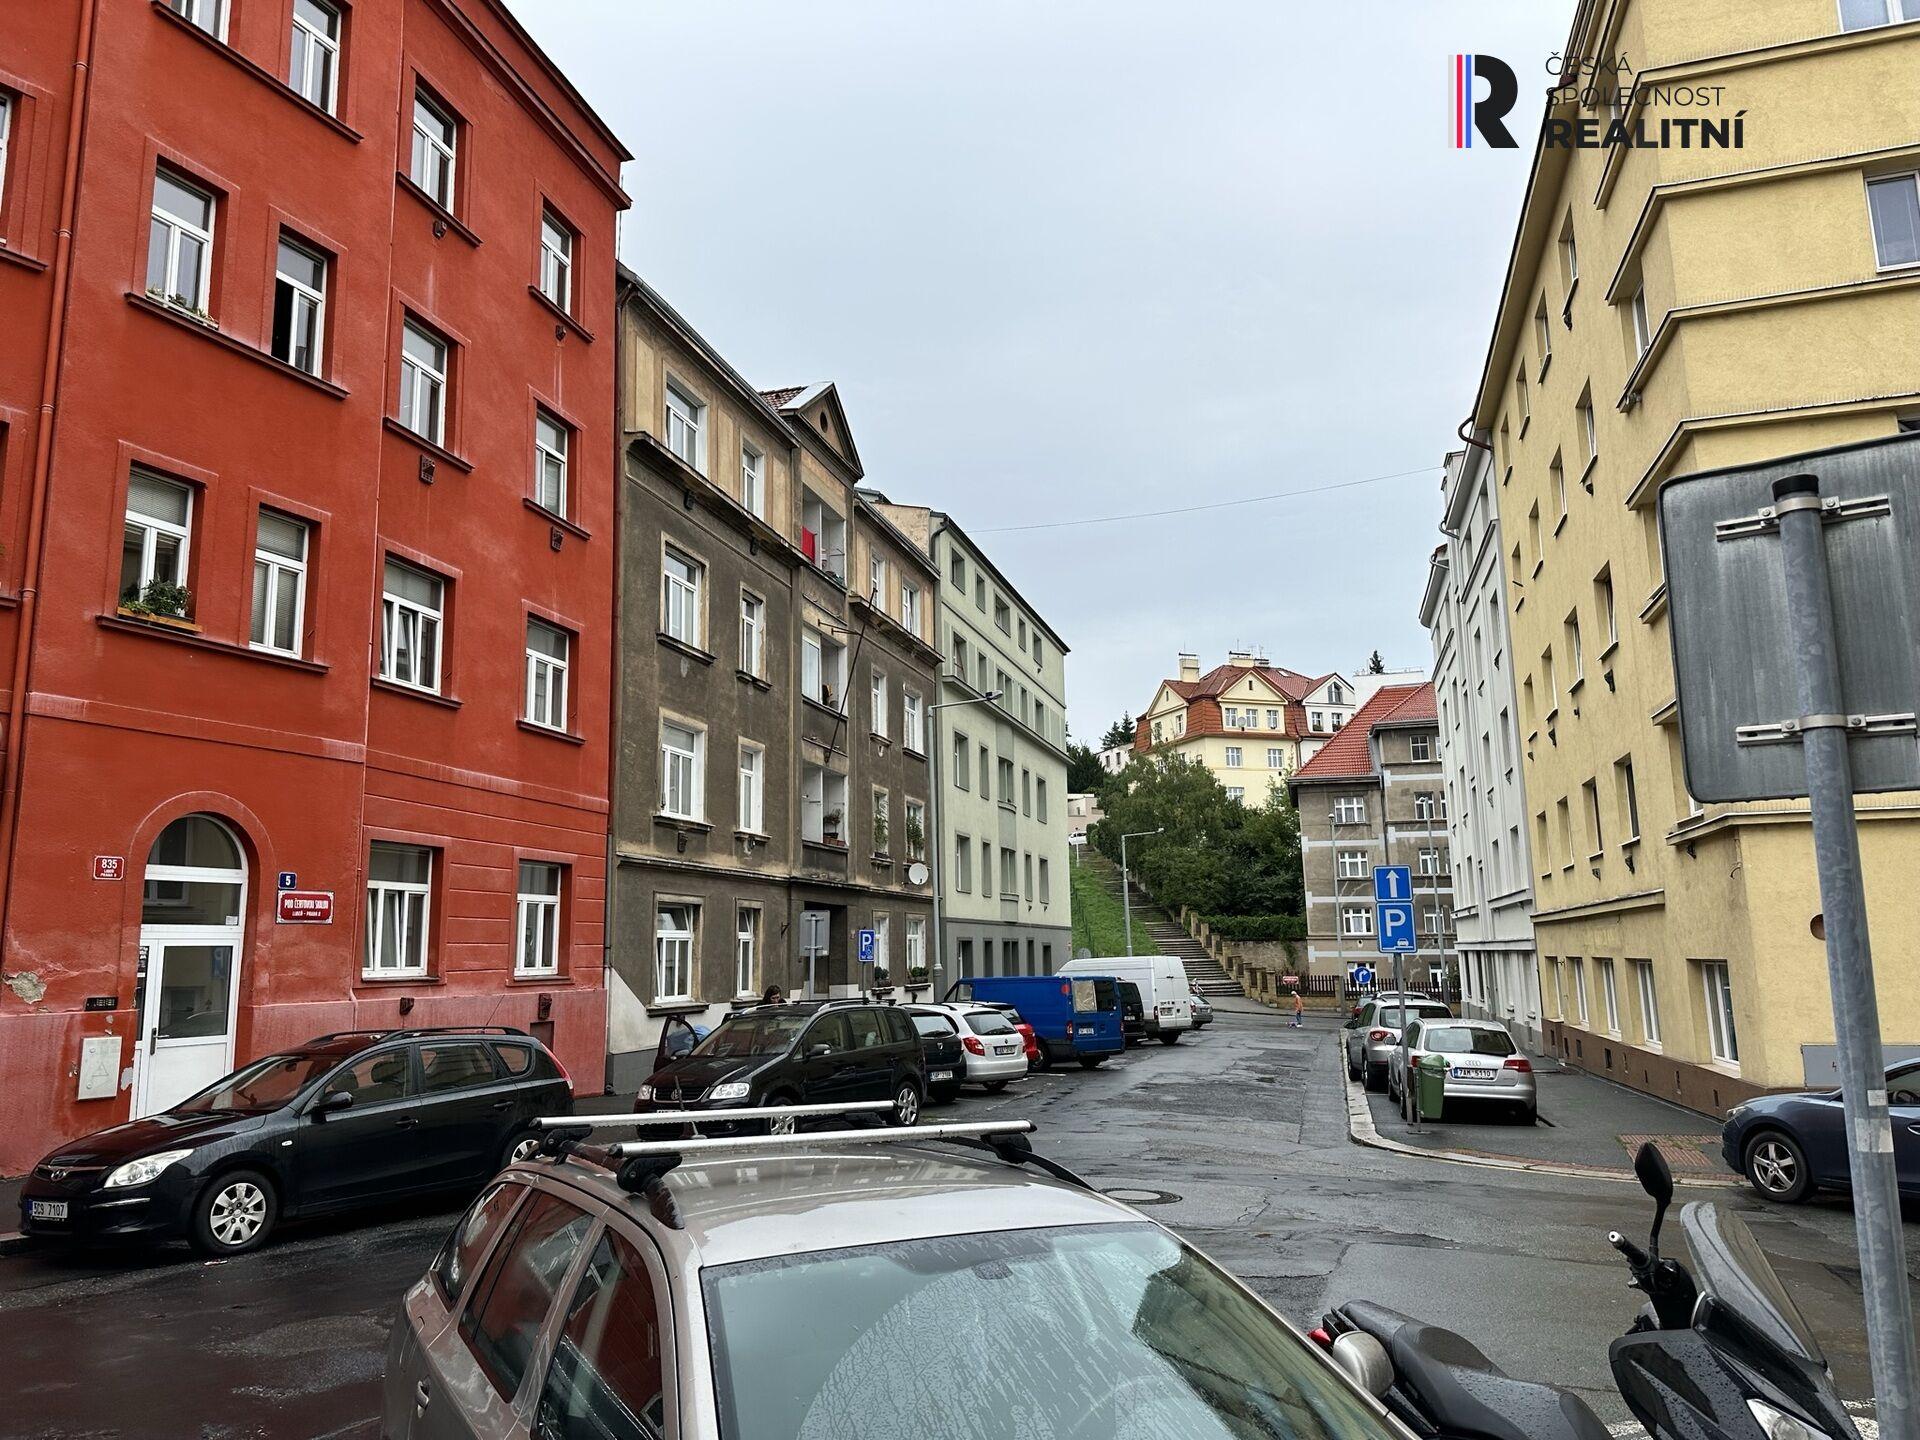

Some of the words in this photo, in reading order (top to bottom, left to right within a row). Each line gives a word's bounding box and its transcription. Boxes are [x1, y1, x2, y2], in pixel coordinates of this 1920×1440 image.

[101, 858, 118, 869] 835
[285, 875, 291, 886] 5
[284, 899, 294, 909] POD
[1385, 908, 1406, 937] P
[862, 933, 872, 952] P
[48, 1203, 65, 1217] 7107
